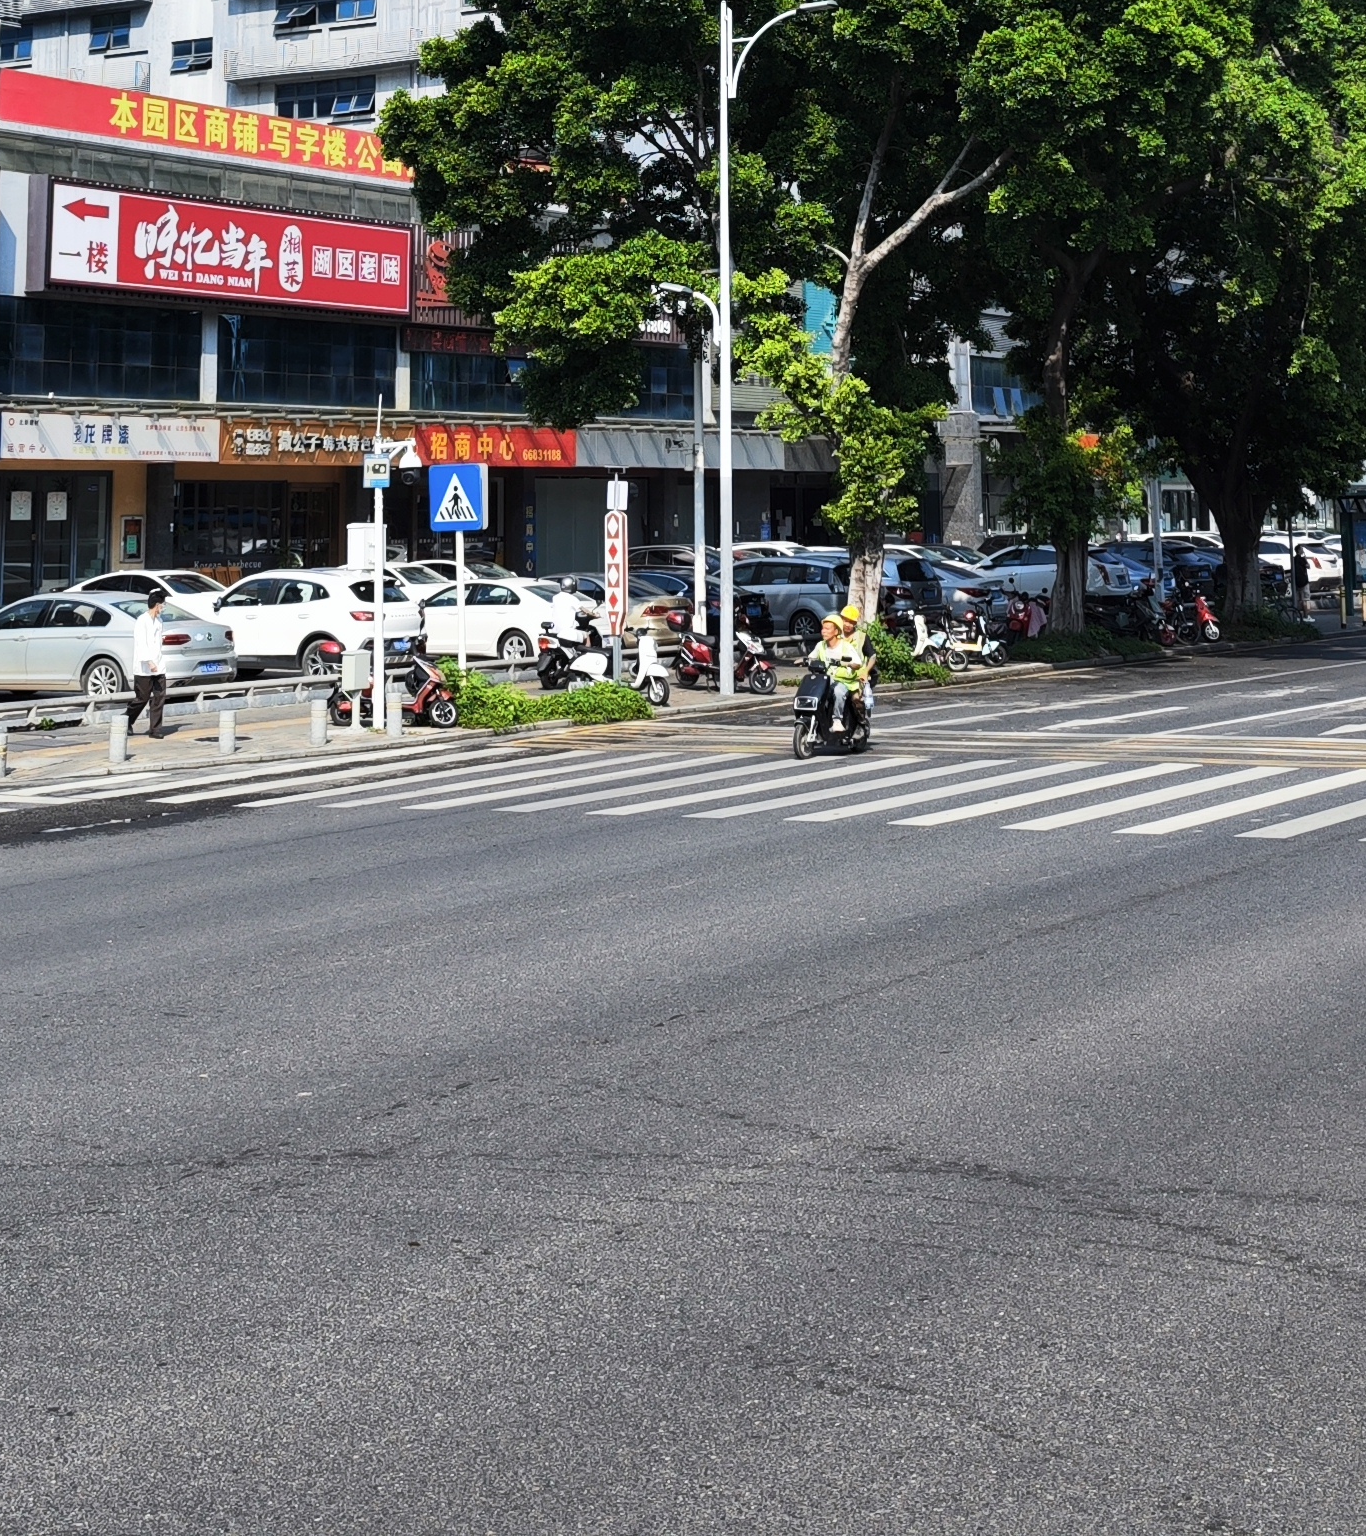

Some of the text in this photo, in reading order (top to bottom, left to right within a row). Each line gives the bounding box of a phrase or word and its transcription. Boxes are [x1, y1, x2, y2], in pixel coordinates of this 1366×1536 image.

[58, 241, 109, 275] 一楼
[282, 231, 302, 288] 湘菜
[313, 247, 400, 284] 湖区老味
[159, 268, 253, 288] WEI YI DANG NIAN
[7, 443, 47, 454] 运营中心
[277, 430, 321, 454] 微公子
[431, 432, 562, 462] 招商中心 66831188
[525, 505, 535, 572] 招商中心
[227, 559, 262, 569] barbecue
